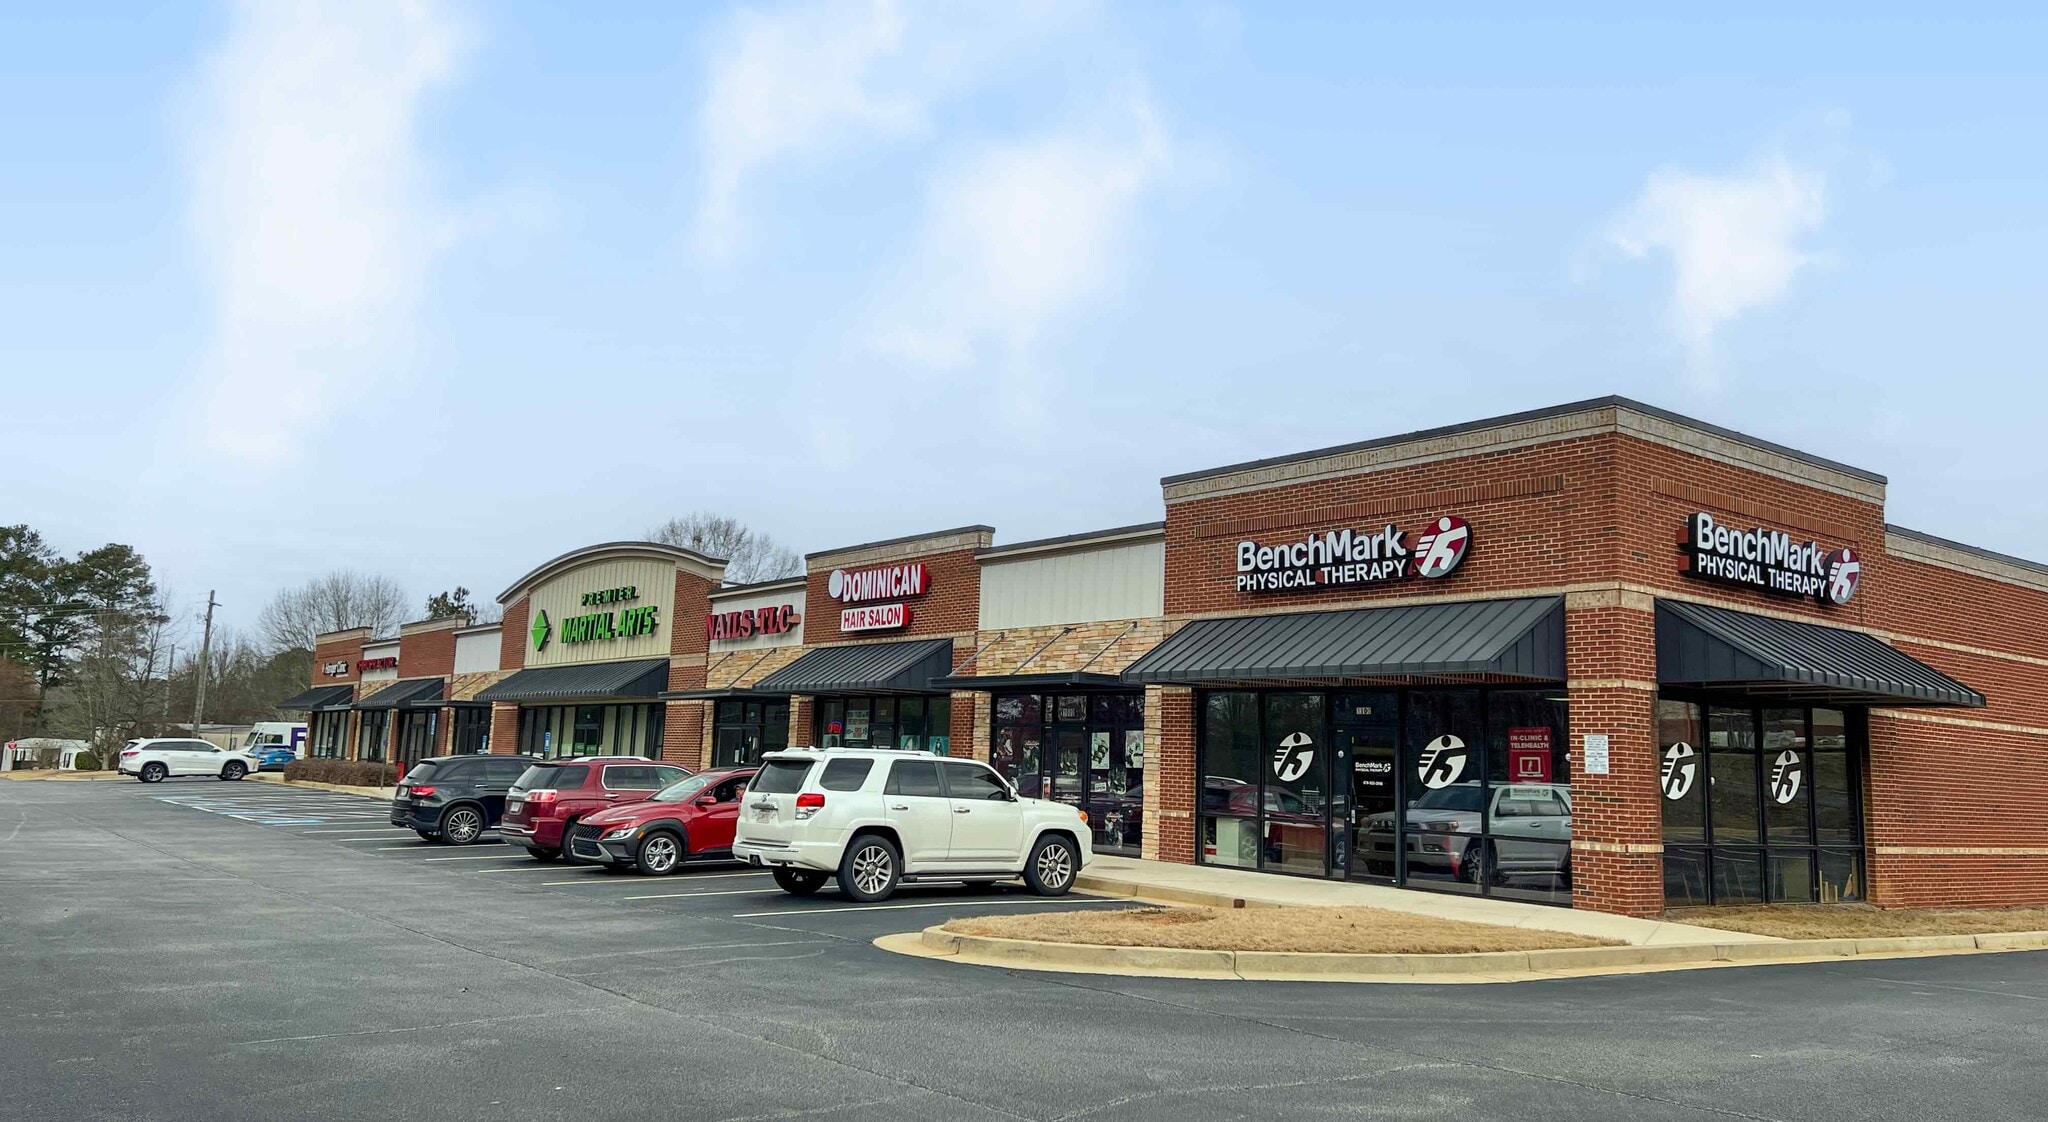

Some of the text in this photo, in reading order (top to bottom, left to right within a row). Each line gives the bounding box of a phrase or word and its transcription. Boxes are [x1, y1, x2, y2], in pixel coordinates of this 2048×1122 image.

[1237, 523, 1407, 572] BenchMark
[1697, 512, 1824, 576] BenchMark
[843, 564, 922, 603] DOMINICAN
[1236, 559, 1407, 592] PHYSICAL THERAPY
[1698, 553, 1827, 598] PHYSICAL THERAPY
[581, 586, 635, 605] PREMIER
[561, 606, 656, 643] MARTIAL ARTS
[705, 605, 791, 640] NAILS TLC
[843, 606, 901, 630] HAIR SALON
